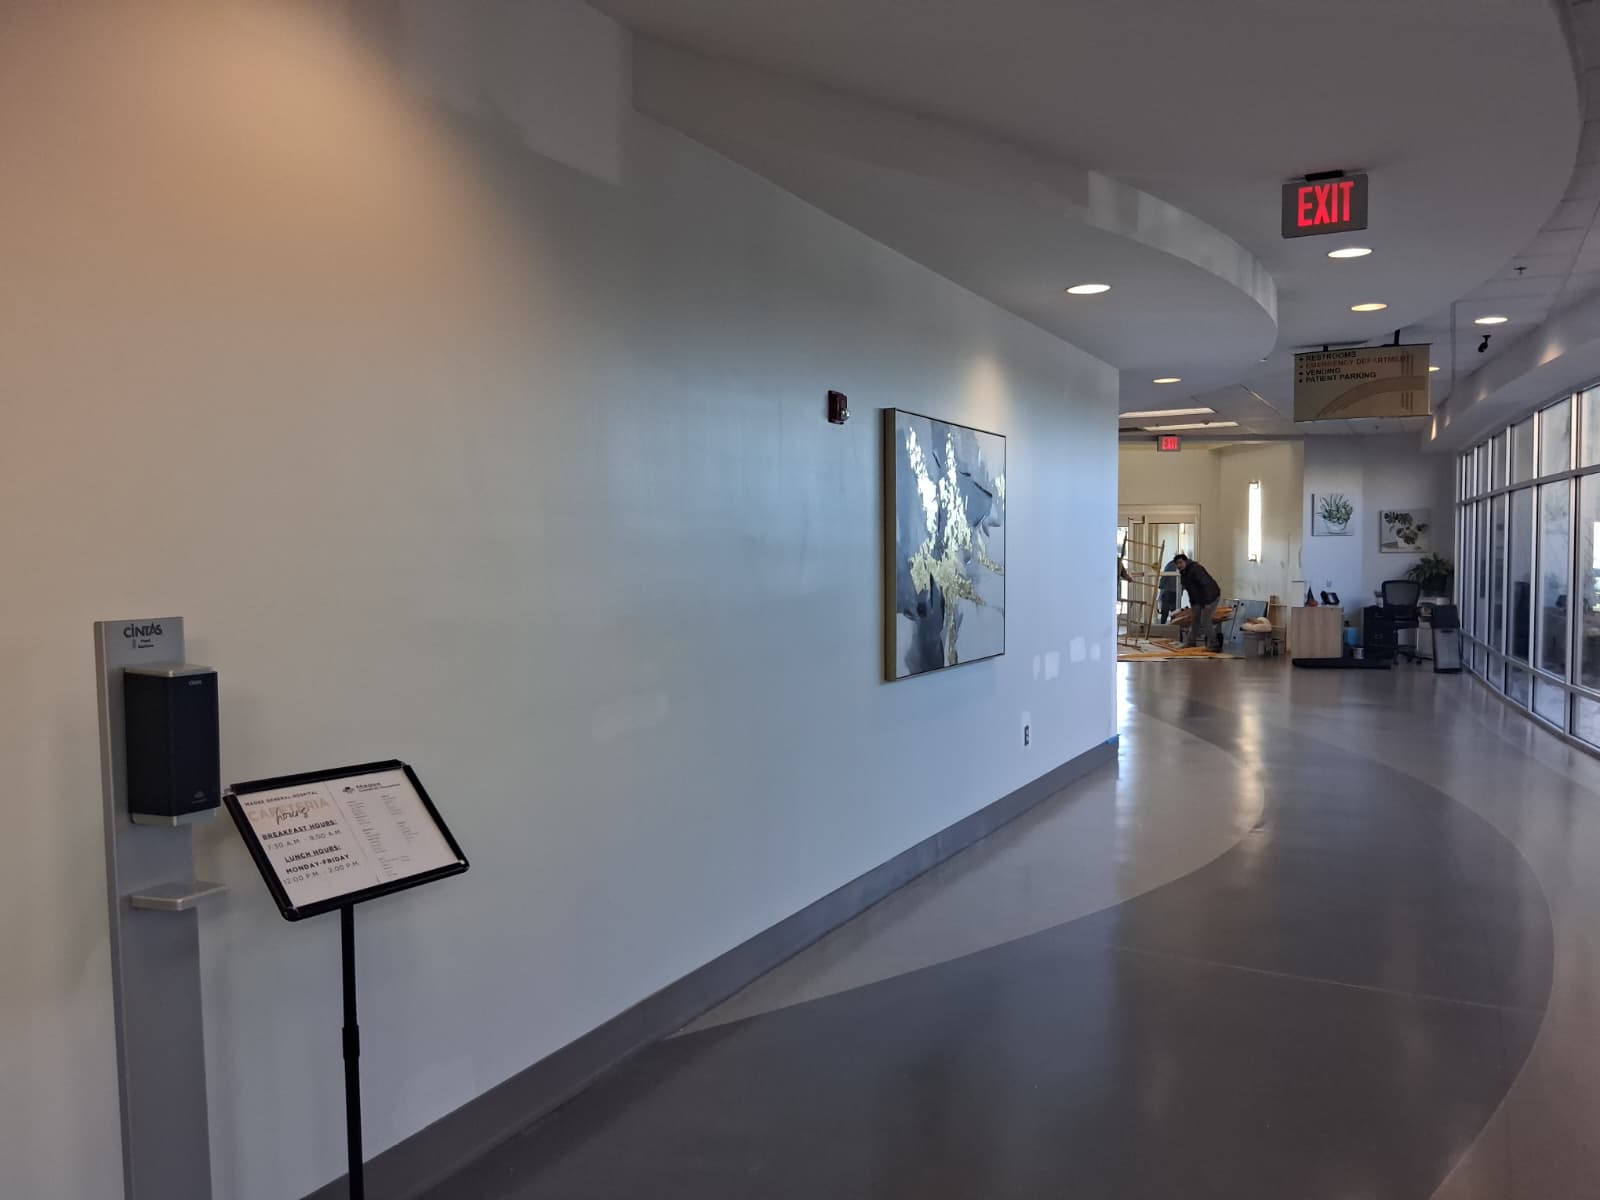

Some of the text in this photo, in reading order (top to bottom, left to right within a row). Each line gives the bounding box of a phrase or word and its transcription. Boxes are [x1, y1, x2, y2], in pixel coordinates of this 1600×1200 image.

[1297, 180, 1354, 227] EXIT
[1306, 350, 1357, 362] RESTROOMS
[1306, 359, 1354, 369] EMERGENCY
[1306, 367, 1341, 376] VENDING
[1306, 371, 1376, 383] PATIENT PARKING
[262, 825, 308, 840] BREAKFAST
[284, 851, 311, 863] LUNCH
[286, 854, 350, 875] MONDAY-FRIDAY
